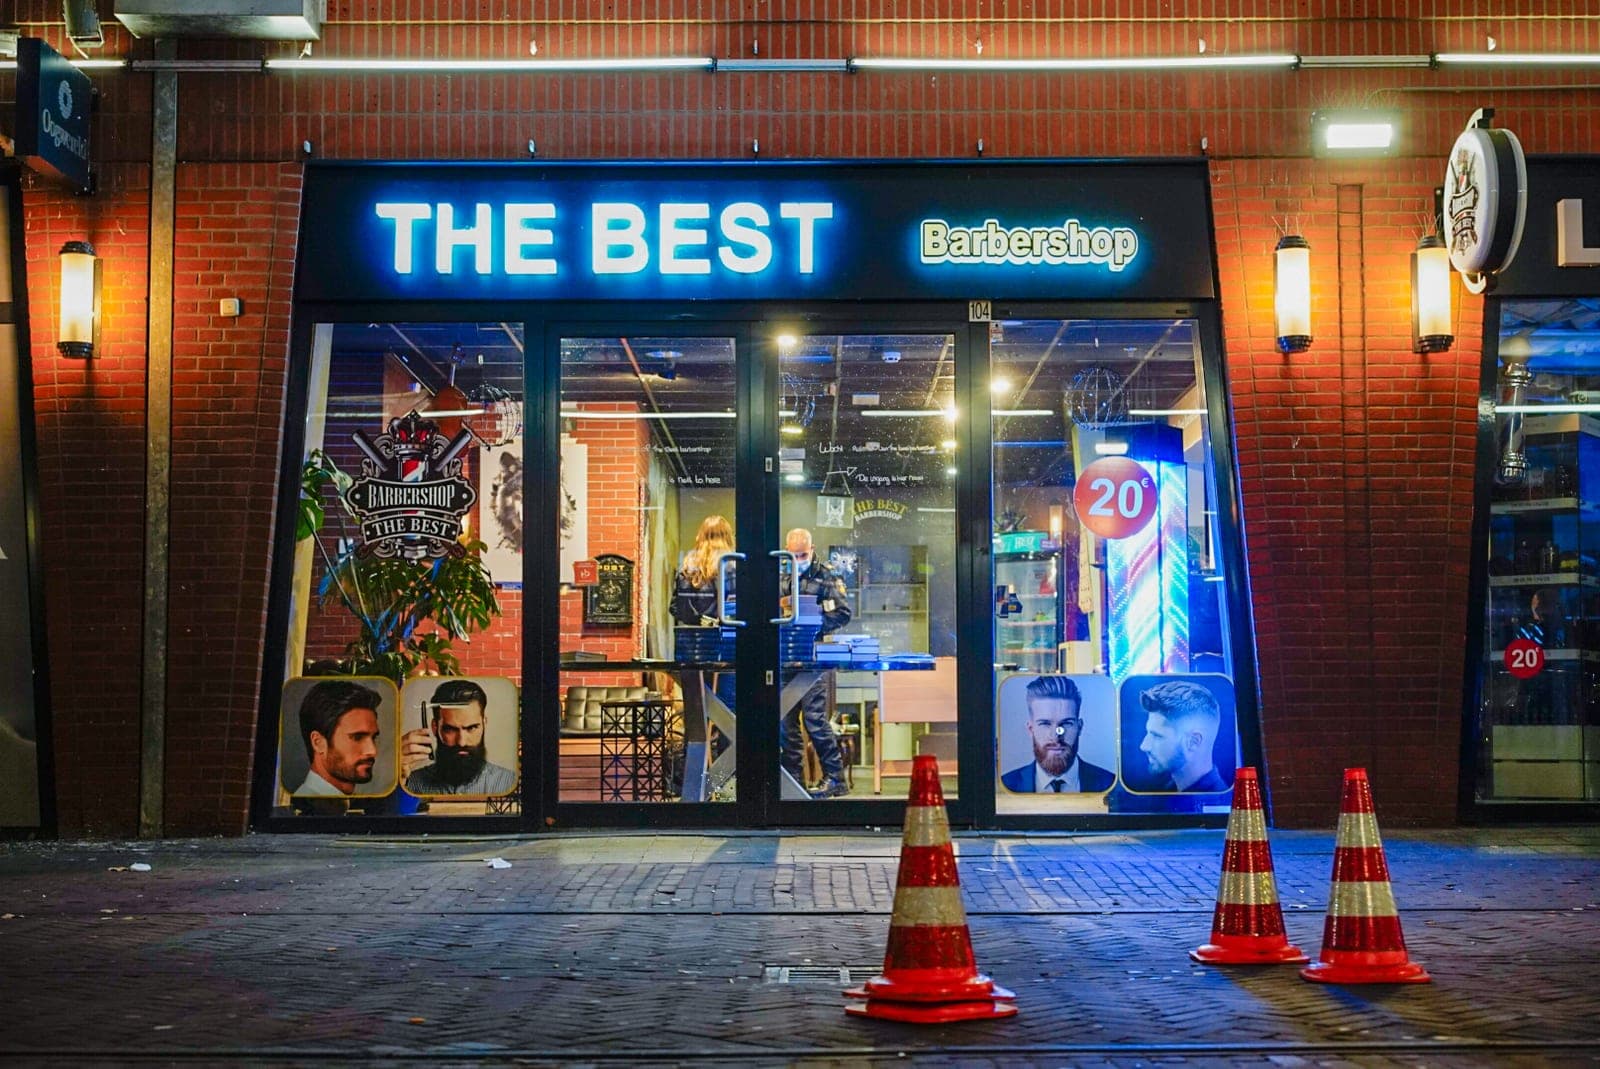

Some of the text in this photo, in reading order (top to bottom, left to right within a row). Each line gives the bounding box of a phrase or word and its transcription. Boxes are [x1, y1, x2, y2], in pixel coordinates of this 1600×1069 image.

[375, 202, 834, 275] THE BEST
[920, 219, 1138, 271] Barbershop
[970, 302, 990, 320] 104
[368, 484, 455, 509] BARBERSHOP
[877, 498, 908, 516] BEST
[372, 518, 450, 535] THE BEST
